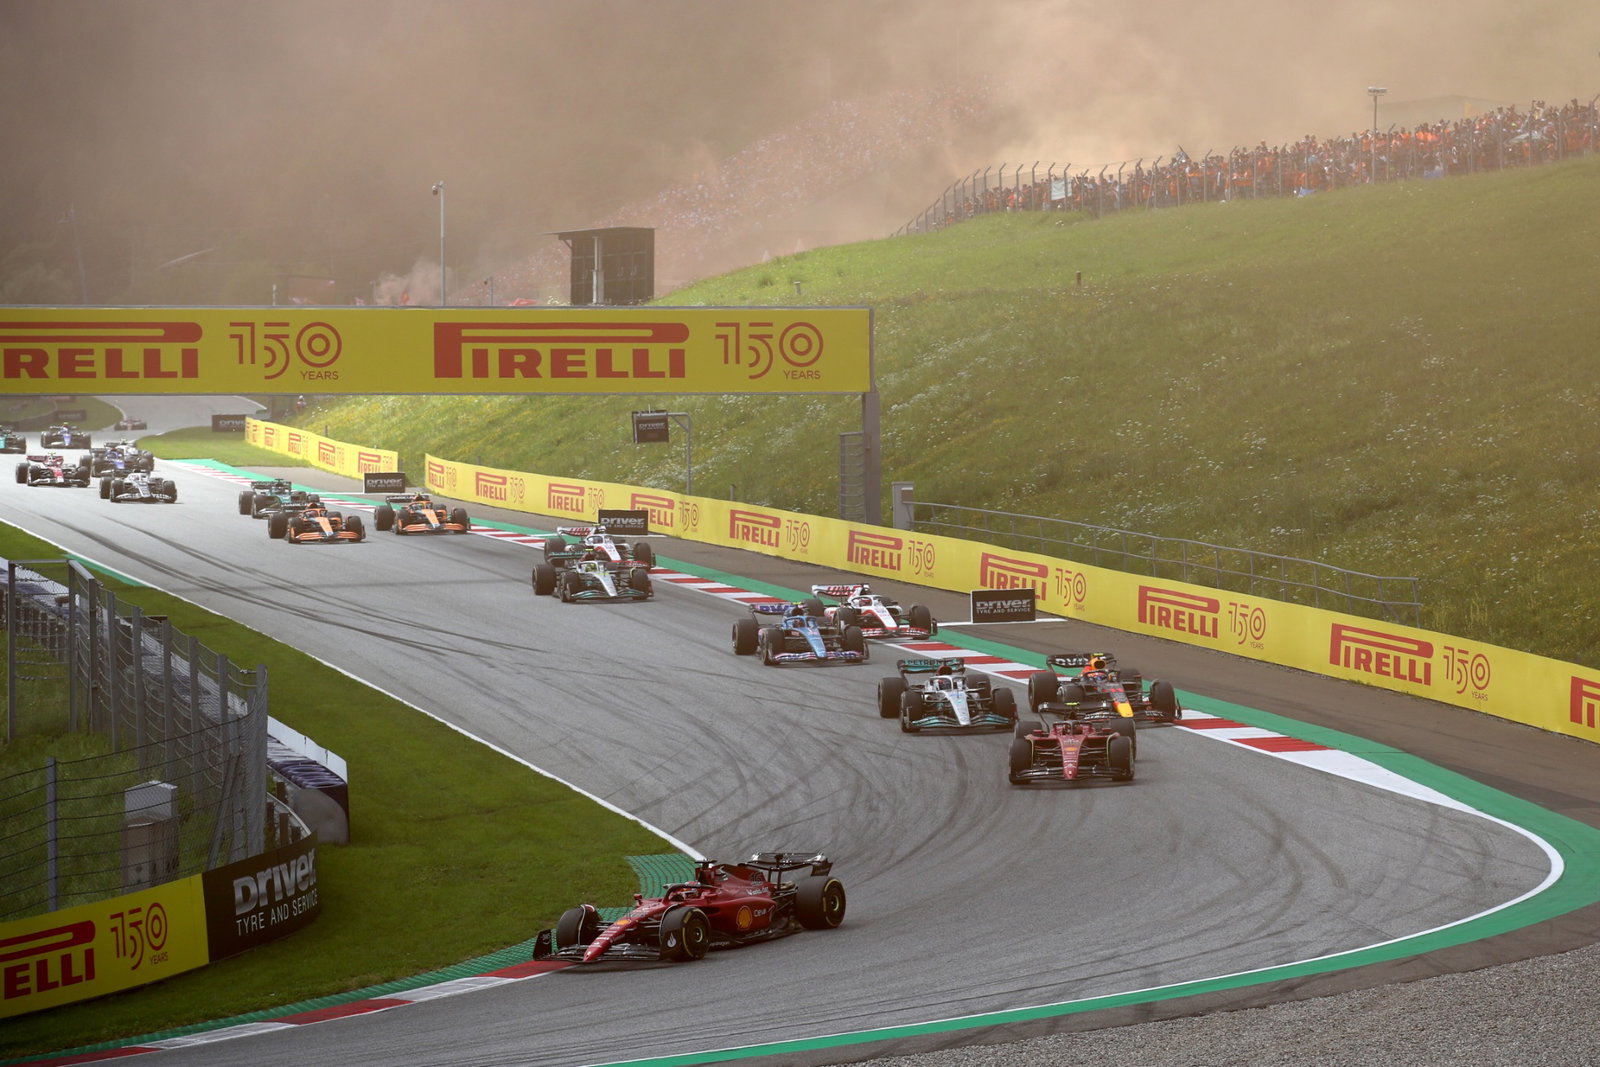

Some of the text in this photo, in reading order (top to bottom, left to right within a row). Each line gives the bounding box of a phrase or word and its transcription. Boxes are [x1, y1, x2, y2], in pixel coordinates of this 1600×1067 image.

[229, 321, 342, 380] 150
[434, 322, 690, 379] PIRELLI
[715, 322, 824, 379] 150
[300, 370, 339, 380] YEARS
[783, 370, 821, 380] YEARS
[428, 461, 444, 489] PIRELLI
[475, 471, 507, 502] PIRELLI
[510, 477, 525, 503] 150
[547, 482, 585, 513] PIRELLI
[679, 500, 699, 531] 150
[729, 509, 781, 548] PIRELLI
[786, 519, 810, 552] 150
[847, 530, 903, 571] PIRELLI
[908, 540, 935, 575] 150
[1055, 568, 1086, 607] 150
[1138, 585, 1220, 639] PIRELLI
[1228, 602, 1266, 645] 150
[1250, 642, 1264, 650] YEARS
[1329, 622, 1434, 686] PIRELLI
[1443, 646, 1491, 694] 150
[1471, 691, 1488, 701] YEARS
[235, 888, 318, 937] TYRE AND SERVICE
[110, 902, 168, 971] 150
[149, 951, 169, 965] YEARS
